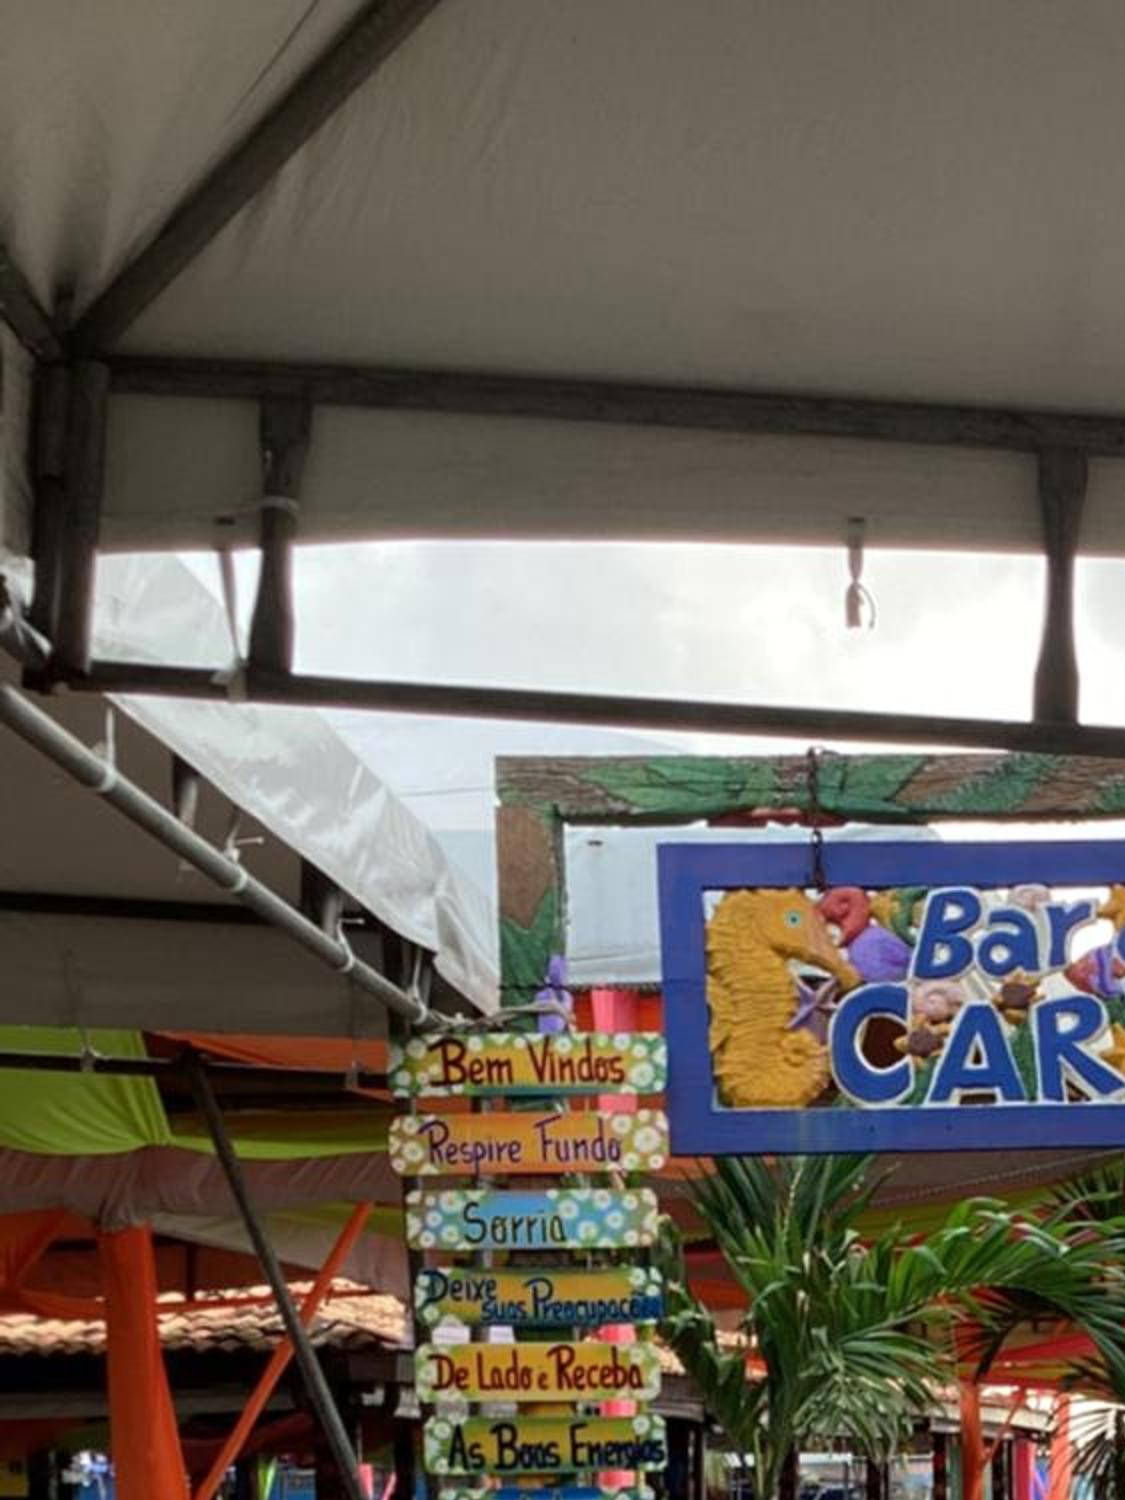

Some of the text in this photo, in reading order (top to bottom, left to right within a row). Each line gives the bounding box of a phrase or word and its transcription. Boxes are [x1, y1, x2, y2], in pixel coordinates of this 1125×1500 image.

[910, 885, 1098, 980] Bar
[427, 1034, 626, 1088] Bem Vindos
[418, 1114, 622, 1178] Respire Fundo
[462, 1200, 568, 1245] Sorria
[421, 1270, 498, 1307] Deixe
[427, 1353, 470, 1391] De
[476, 1349, 534, 1391] Lado
[547, 1345, 643, 1391] Receba
[450, 1423, 486, 1470] As
[490, 1423, 559, 1470] Boas
